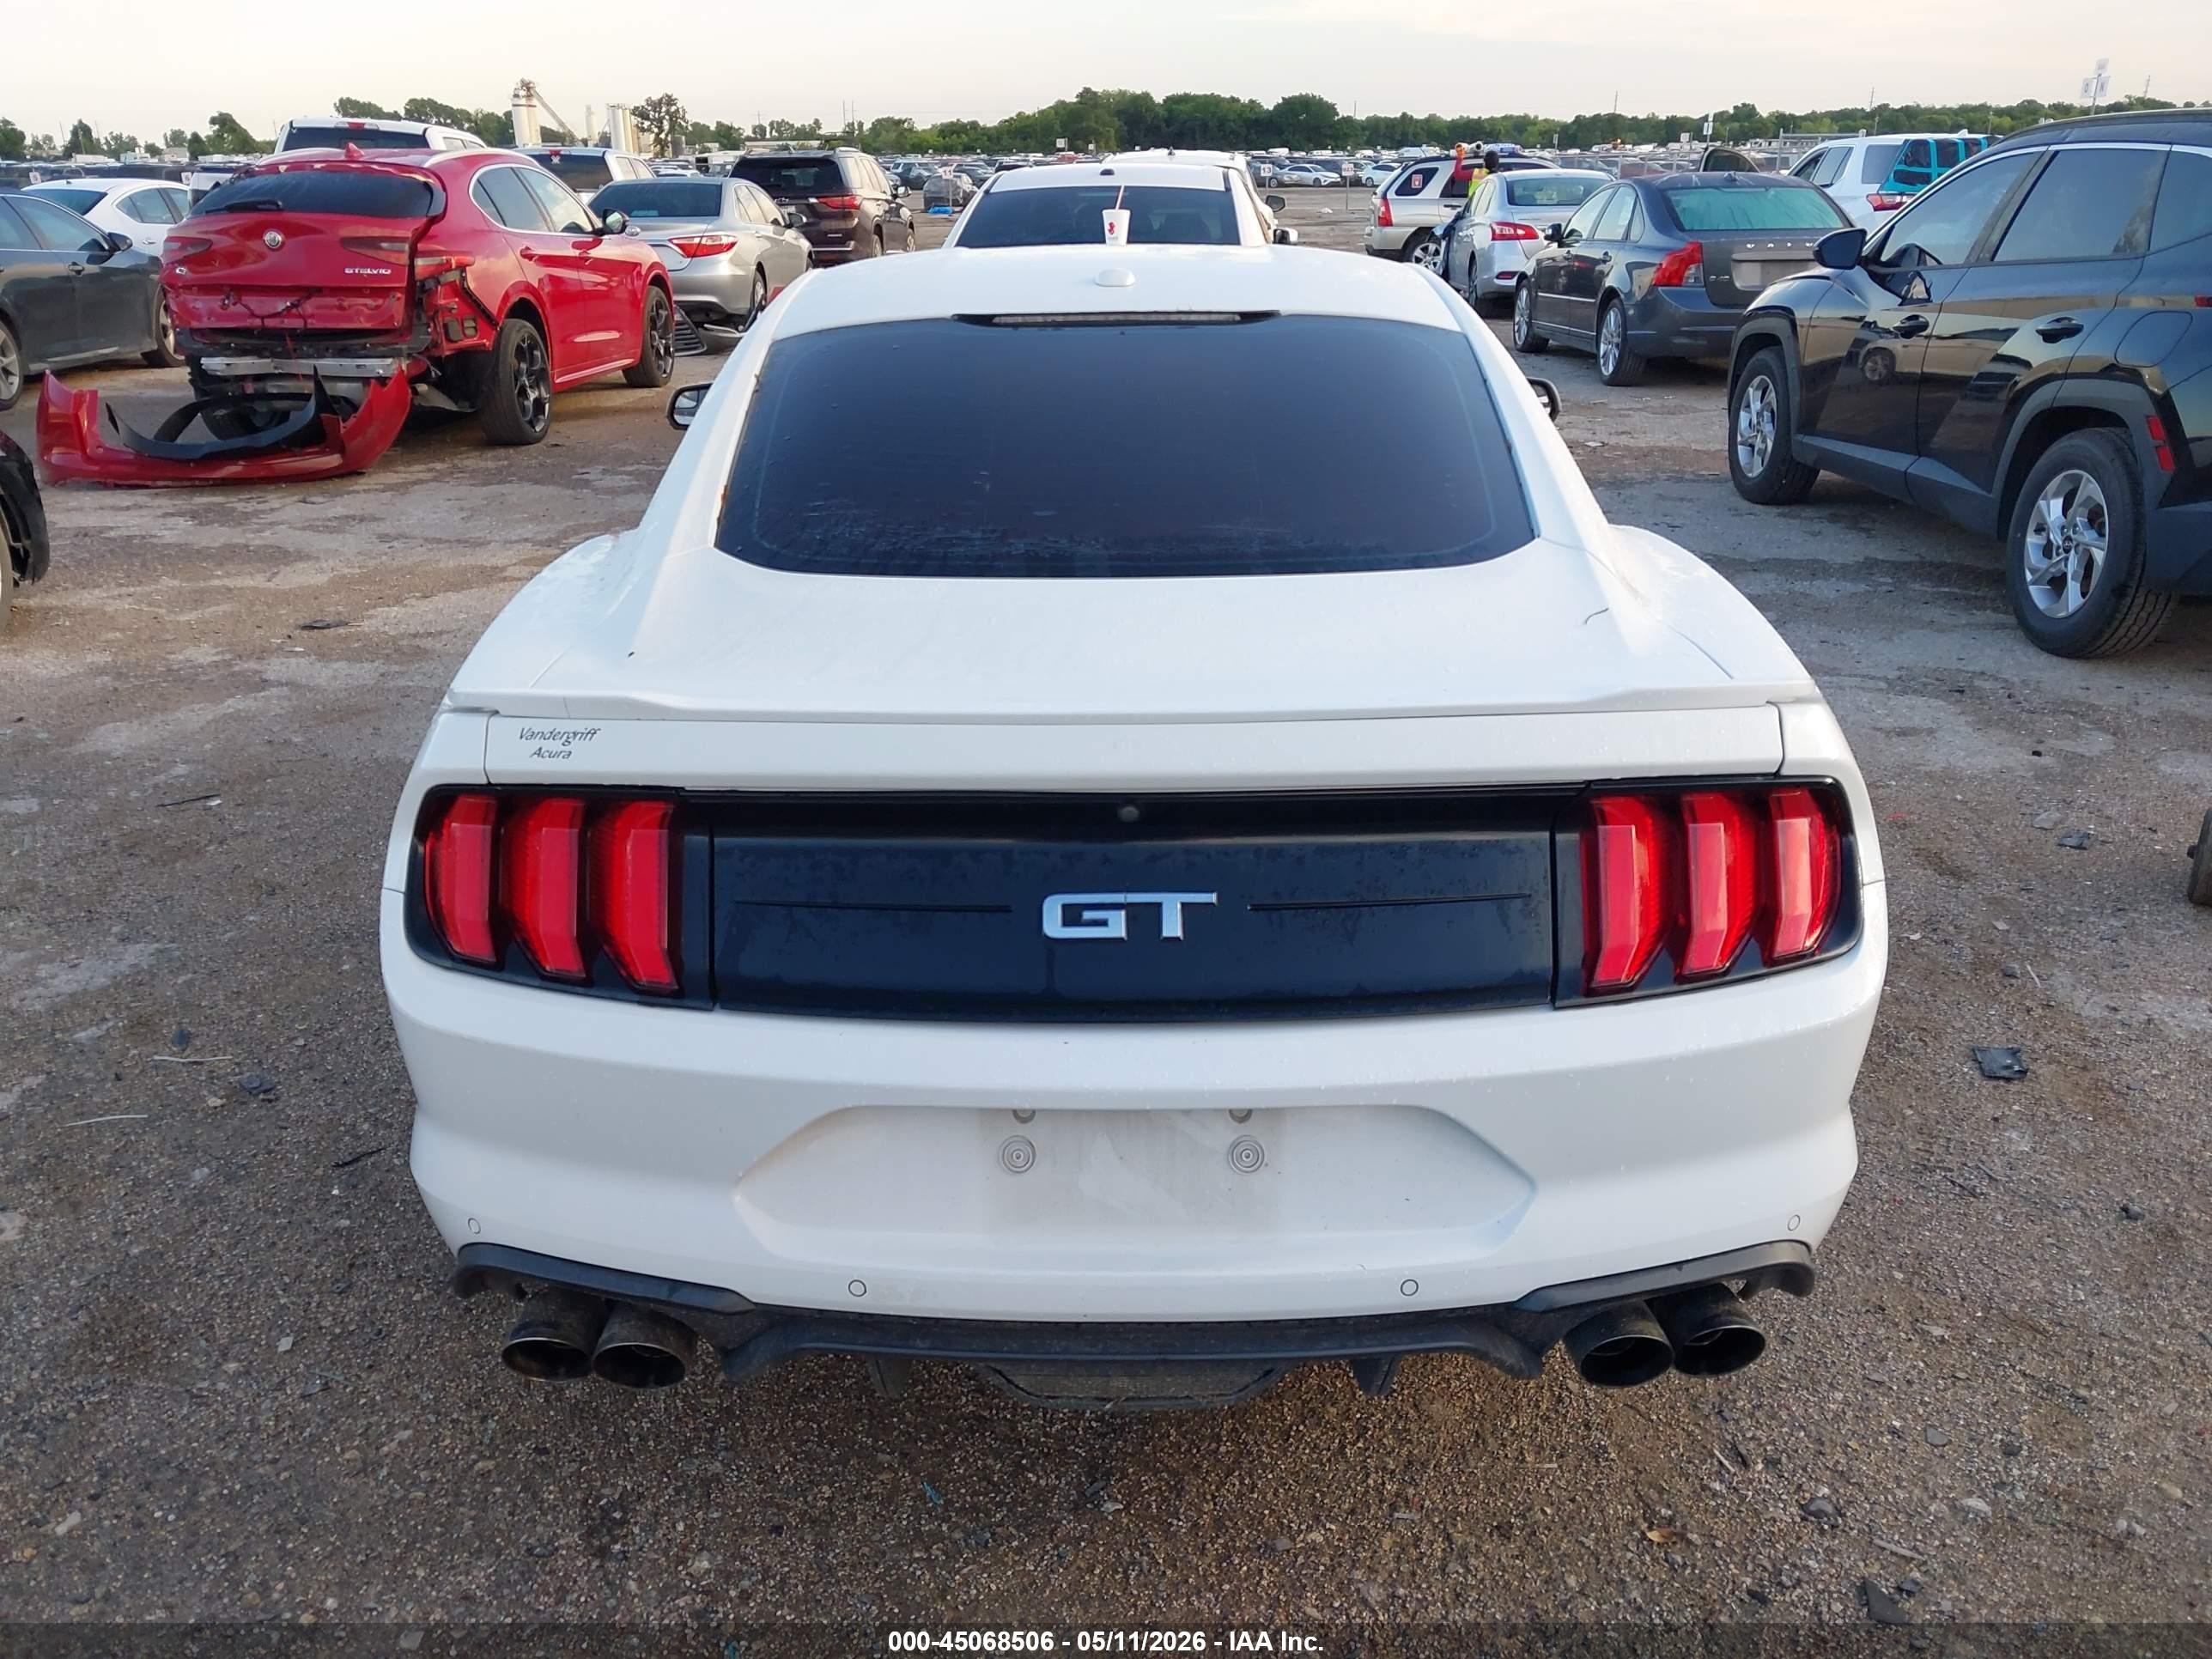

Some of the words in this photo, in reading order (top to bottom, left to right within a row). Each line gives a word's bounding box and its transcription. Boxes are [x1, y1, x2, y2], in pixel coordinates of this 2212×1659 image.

[519, 727, 601, 747] Vandergriff
[529, 746, 573, 760] Acura
[1042, 891, 1218, 941] GT
